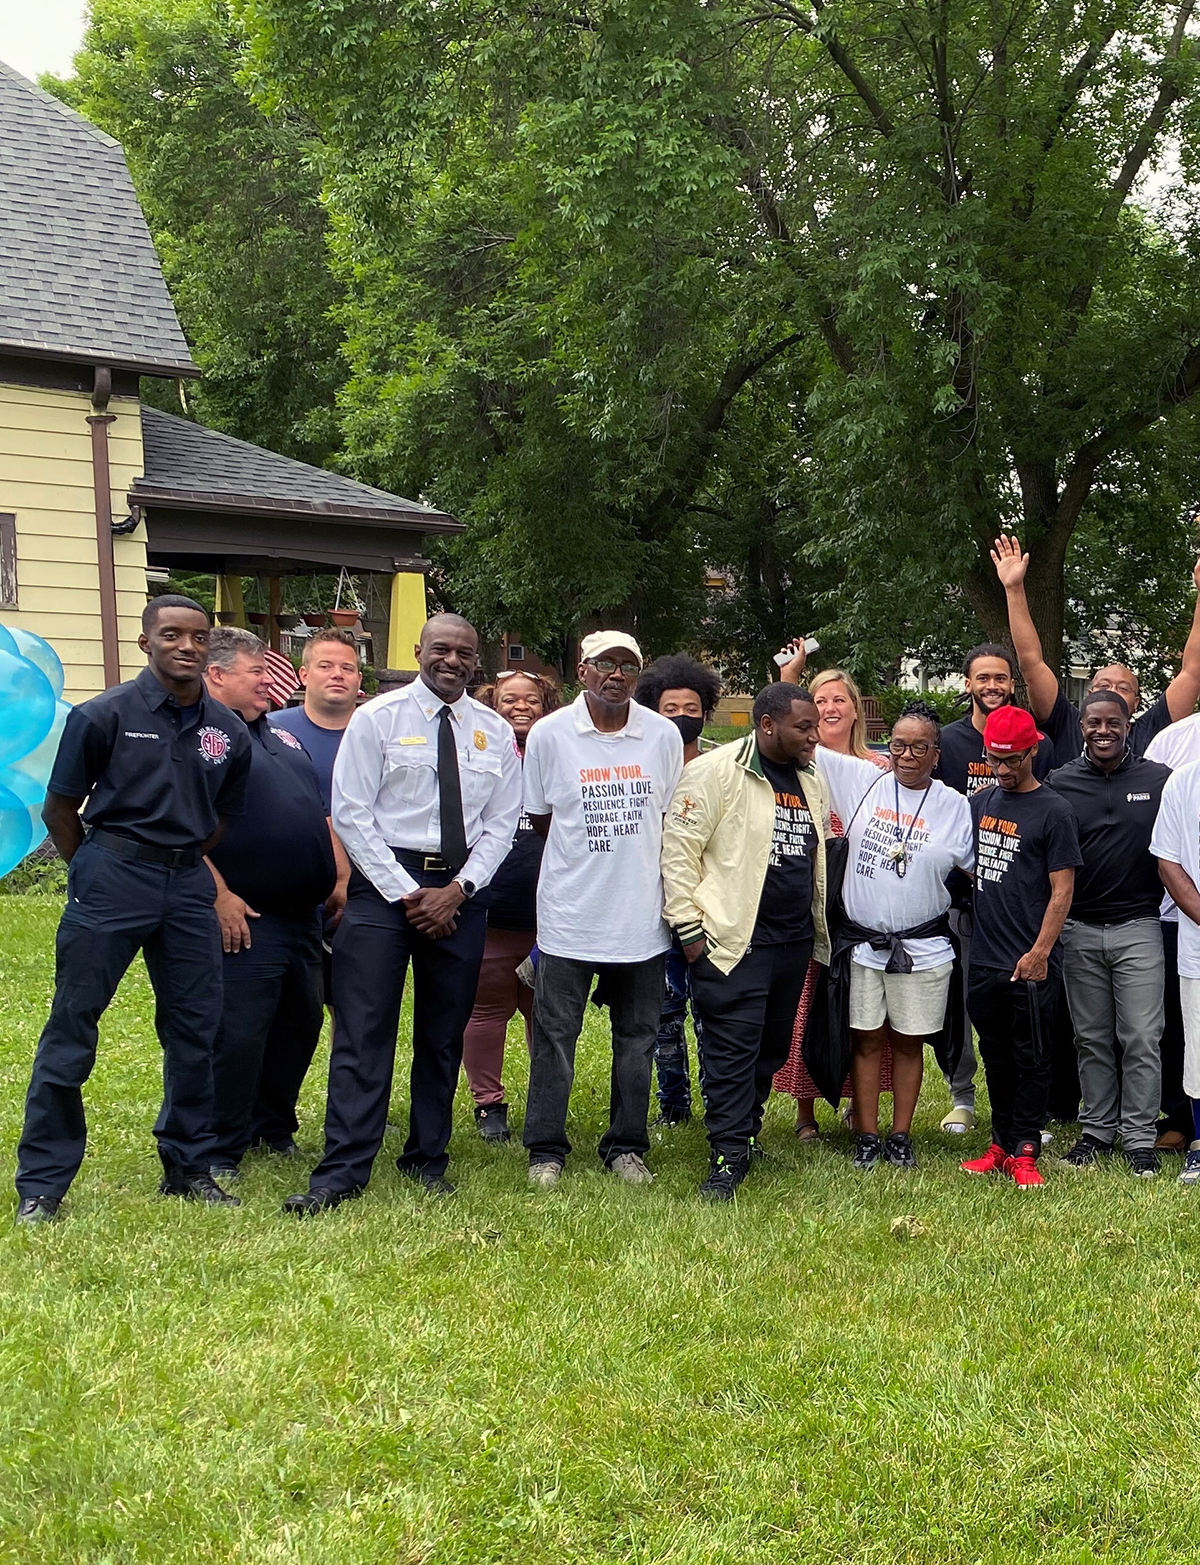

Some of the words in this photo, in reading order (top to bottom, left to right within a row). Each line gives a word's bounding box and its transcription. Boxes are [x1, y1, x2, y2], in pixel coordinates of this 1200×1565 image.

[580, 767, 610, 783] SHOW
[582, 783, 628, 799] PASSION.
[631, 781, 653, 795] LOVE.
[583, 799, 628, 811] RESILIENCE.
[630, 797, 649, 808] FIGHT.
[585, 812, 621, 824] COURAGE.
[623, 810, 643, 821] FAITH.
[587, 826, 611, 837] HOPE.
[614, 823, 641, 836] HEART.
[589, 840, 614, 852] CARE.
[1003, 836, 1020, 852] LOVE.
[858, 850, 877, 866] HOPE.
[880, 858, 896, 872] HEA
[856, 862, 875, 880] CARE.
